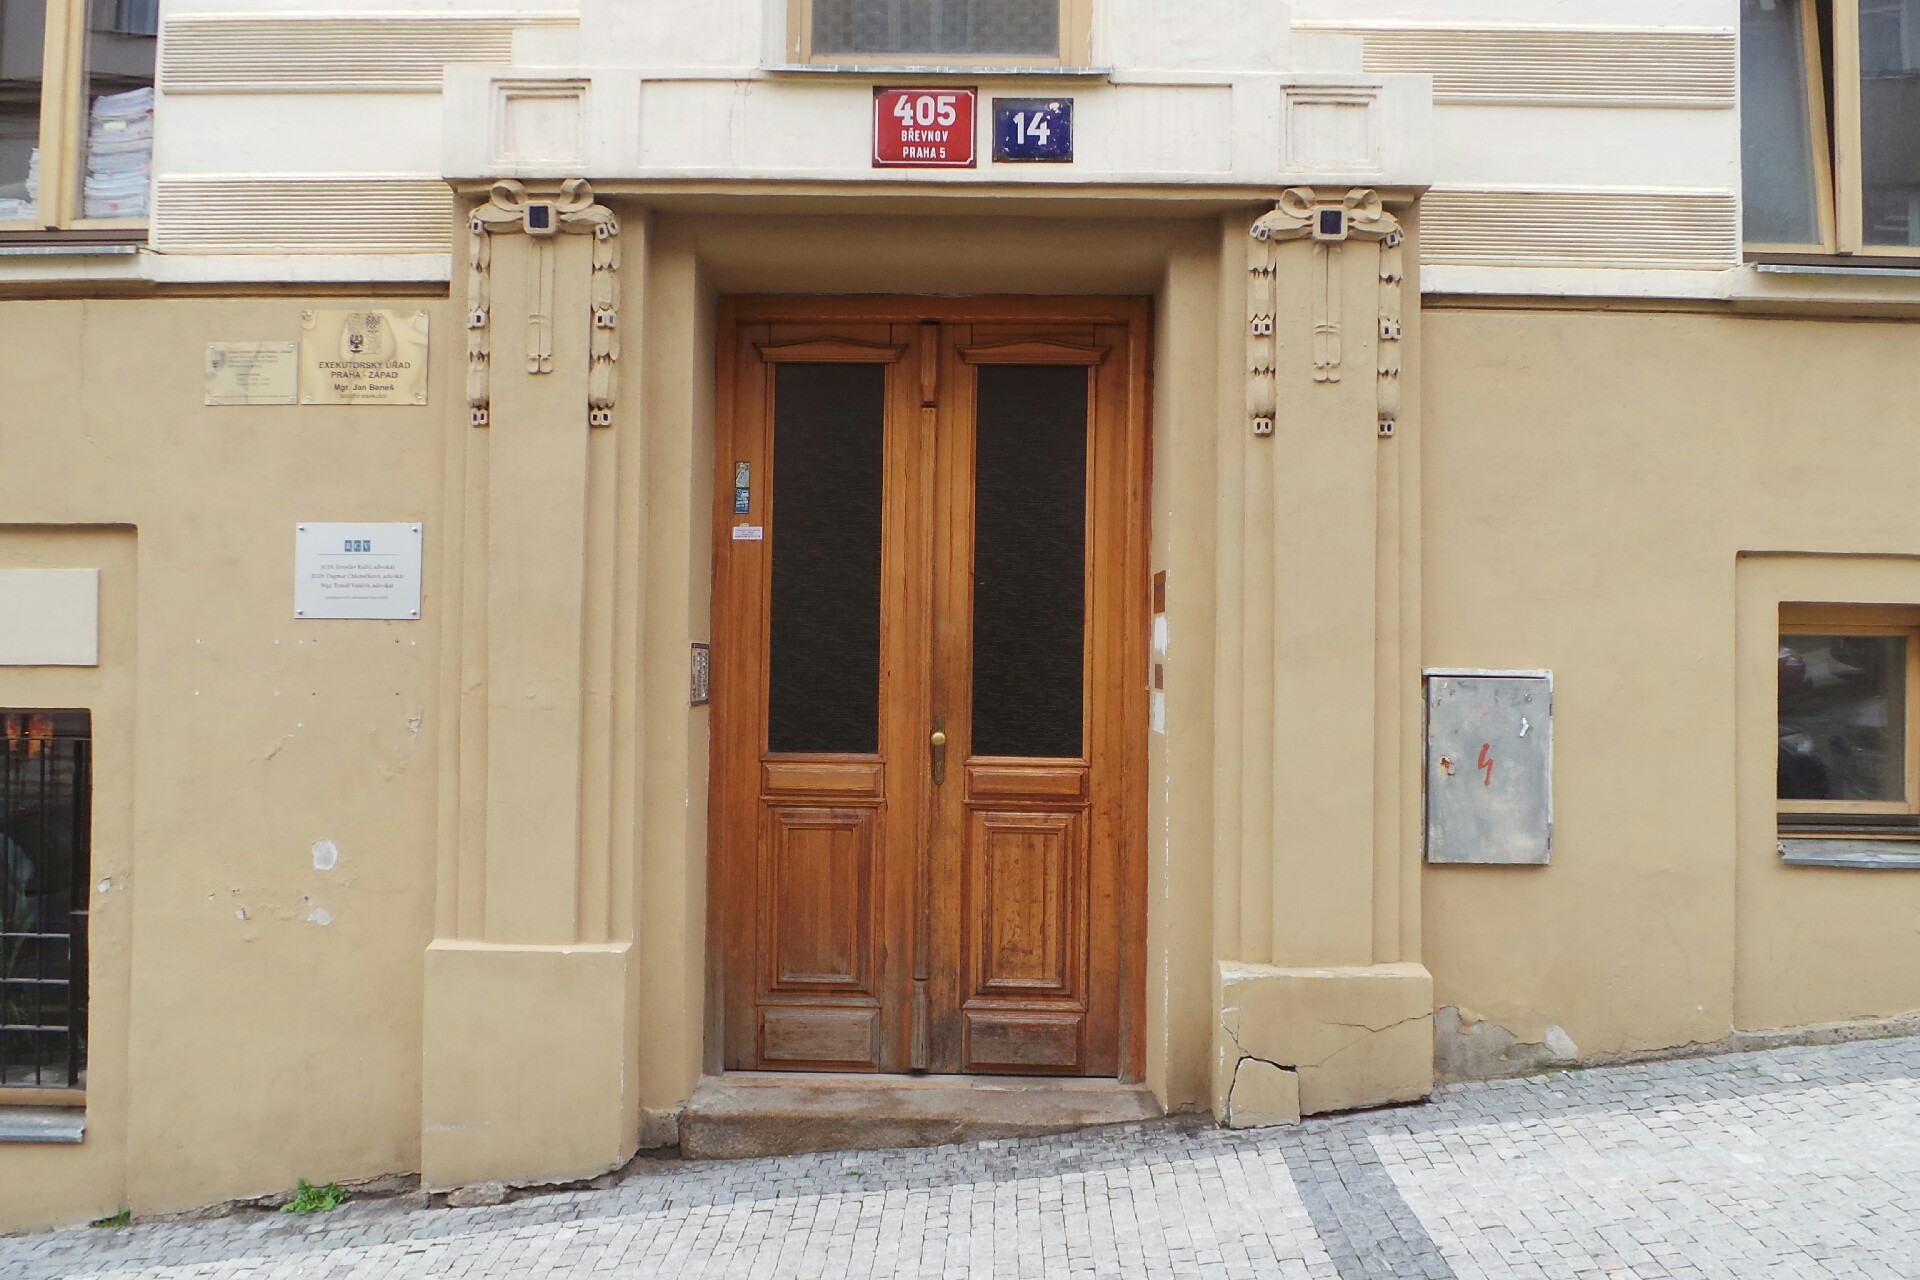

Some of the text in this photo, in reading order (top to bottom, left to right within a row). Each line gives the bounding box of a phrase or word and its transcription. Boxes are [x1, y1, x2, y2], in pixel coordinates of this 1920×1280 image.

[893, 95, 956, 126] 405
[901, 127, 949, 142] BŘEVNOV
[1012, 112, 1051, 145] 14
[902, 146, 946, 159] PRAHA 5
[318, 360, 411, 369] EXEKUTORSKÝ ÚŘAD
[330, 371, 361, 379] PRAHA
[368, 370, 398, 379] ZÁPAD
[333, 383, 394, 392] Mgr. Jan Beneš
